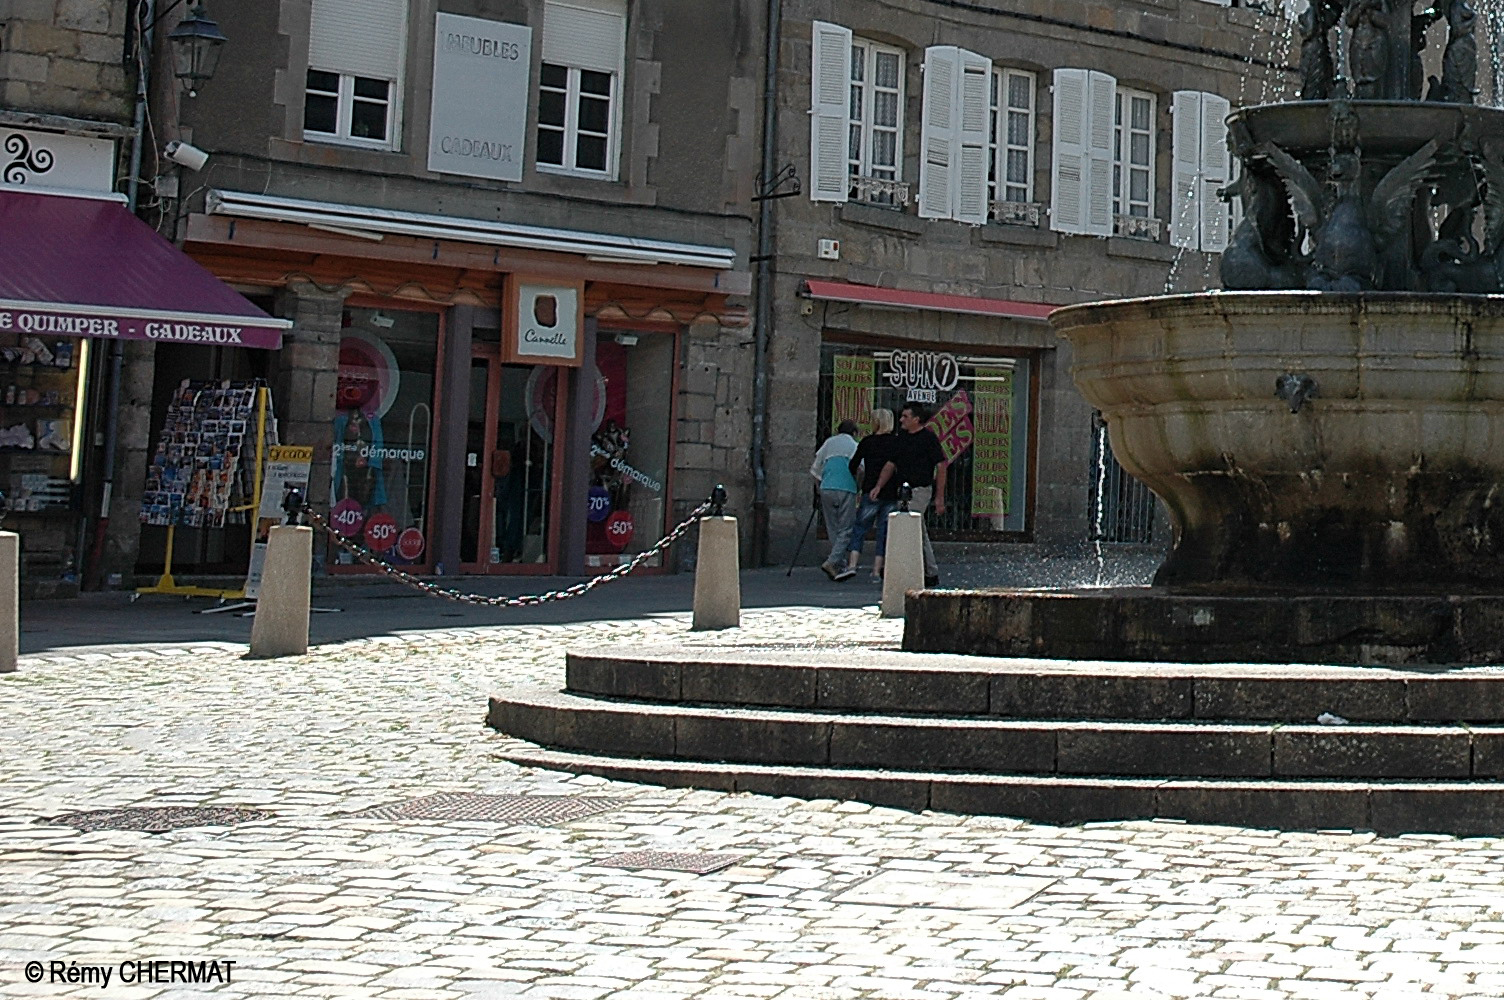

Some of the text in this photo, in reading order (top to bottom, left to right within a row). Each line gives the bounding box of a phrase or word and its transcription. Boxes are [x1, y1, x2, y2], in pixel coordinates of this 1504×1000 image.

[446, 33, 520, 61] MEUBLES
[441, 136, 513, 162] CADEAUX
[18, 313, 119, 337] QUIMPER
[145, 322, 242, 344] CADEAUX
[524, 328, 567, 345] Cannelle
[836, 360, 872, 371] SOLDES
[836, 374, 872, 383] SOLDES
[835, 386, 873, 424] SOLDES
[976, 397, 1009, 434] SOLDES
[975, 438, 1008, 446] SOLDES
[360, 445, 425, 462] démarque
[975, 450, 1008, 458] SOLDES
[610, 457, 661, 491] démarque
[975, 463, 1008, 471] SOLDES
[975, 475, 1008, 483] SOLDES
[334, 510, 362, 524] -40%
[368, 525, 397, 539] -50%
[608, 521, 633, 535] -50%
